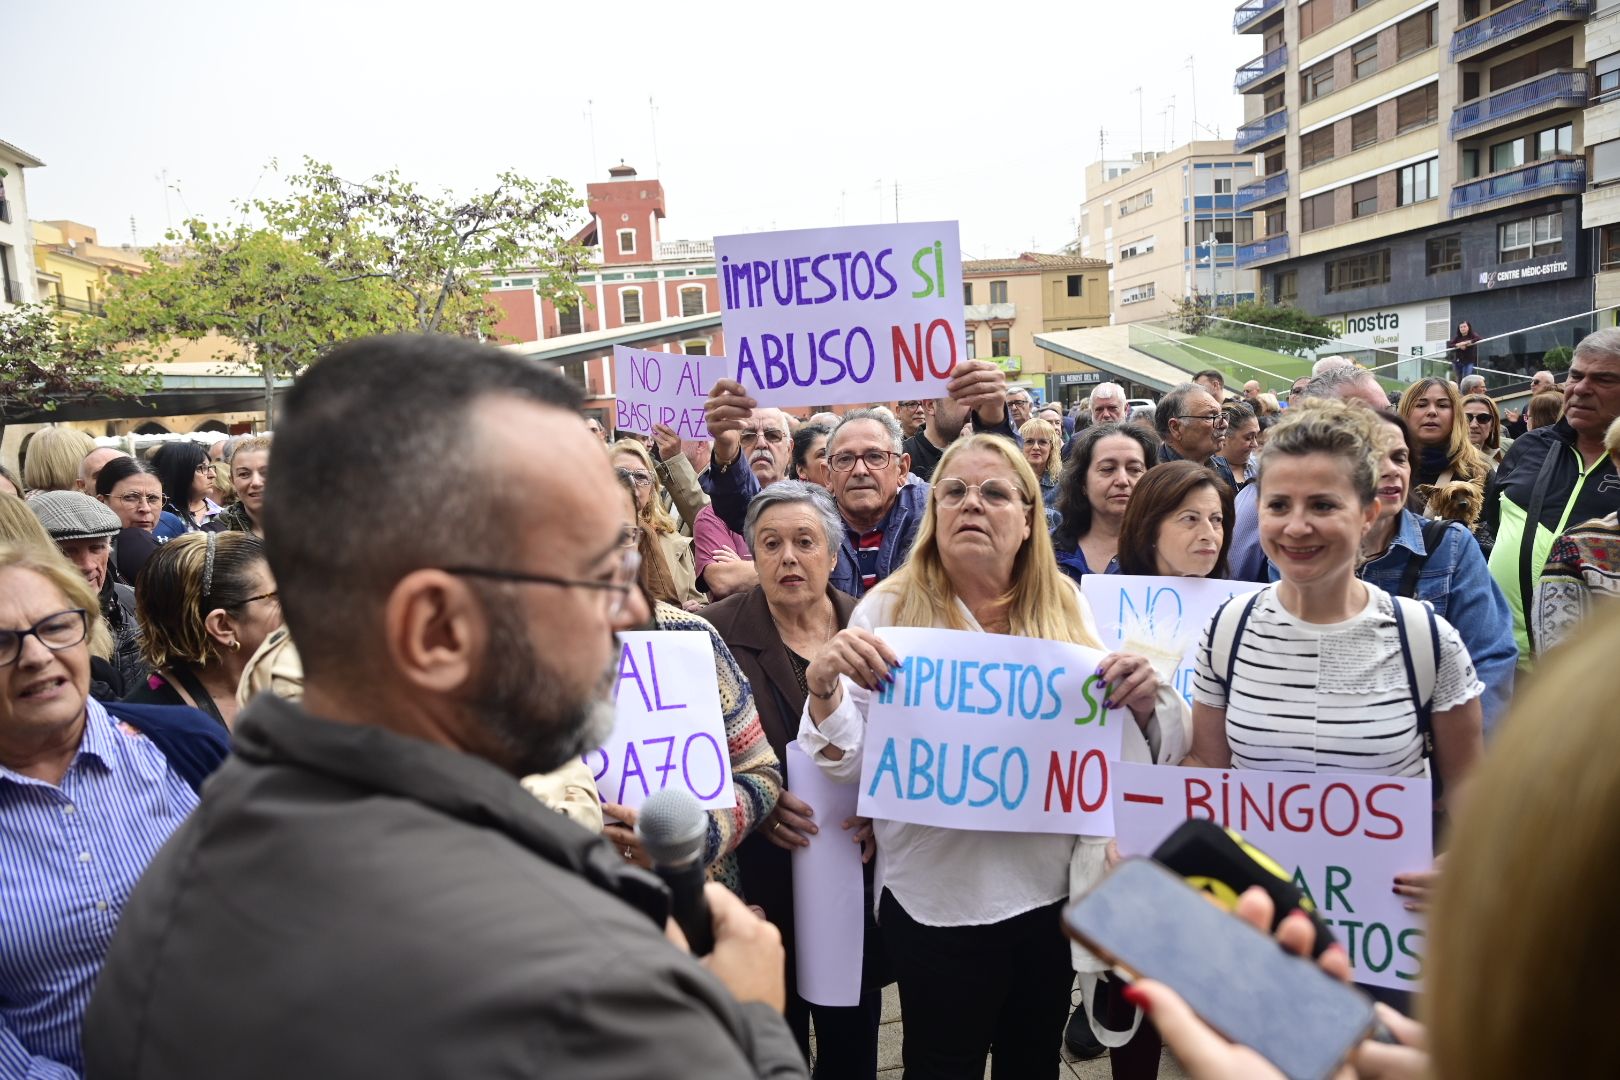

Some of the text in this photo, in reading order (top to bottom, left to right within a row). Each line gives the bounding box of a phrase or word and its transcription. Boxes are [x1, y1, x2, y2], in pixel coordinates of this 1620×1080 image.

[1497, 269, 1520, 282] CENTRE
[736, 318, 957, 390] ABUSO NO
[1373, 333, 1399, 345] Vila-real
[630, 355, 709, 397] NO AL
[616, 399, 714, 438] BASURAZ
[867, 737, 1108, 813] ABUSO NO
